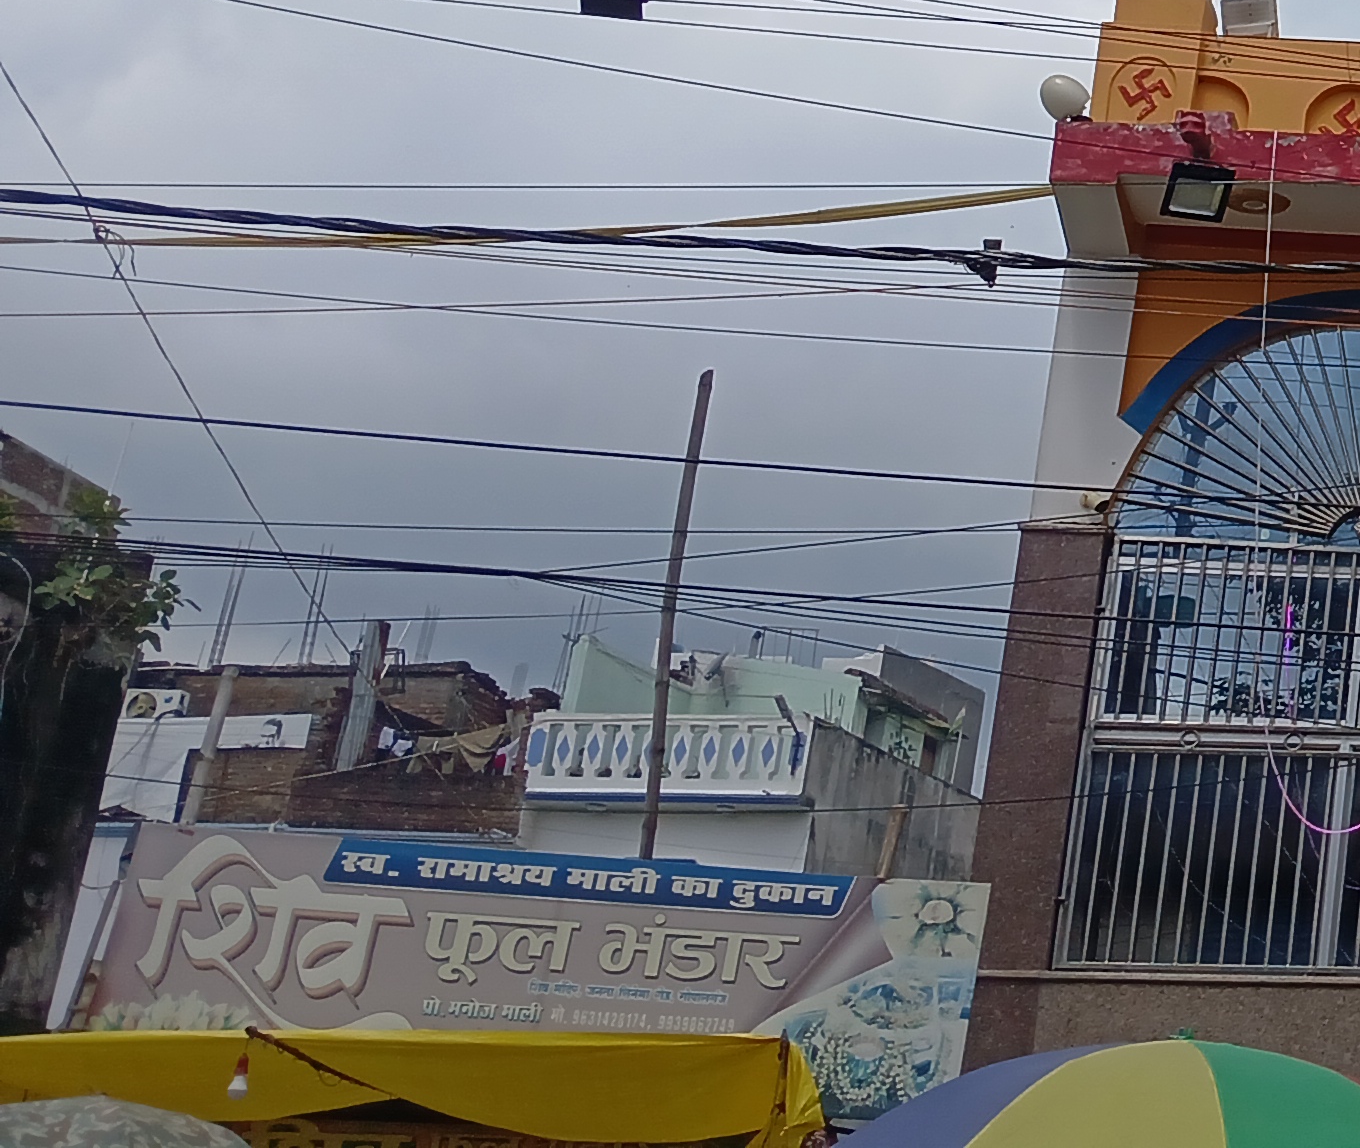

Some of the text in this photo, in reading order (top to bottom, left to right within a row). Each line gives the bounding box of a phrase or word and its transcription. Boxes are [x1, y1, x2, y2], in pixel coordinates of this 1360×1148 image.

[340, 851, 840, 909] स्व. रामाश्रय माली का दुकान
[135, 834, 802, 1032] शिव फूल भंडार
[449, 998, 498, 1020] मनोज
[501, 1001, 544, 1023] माली
